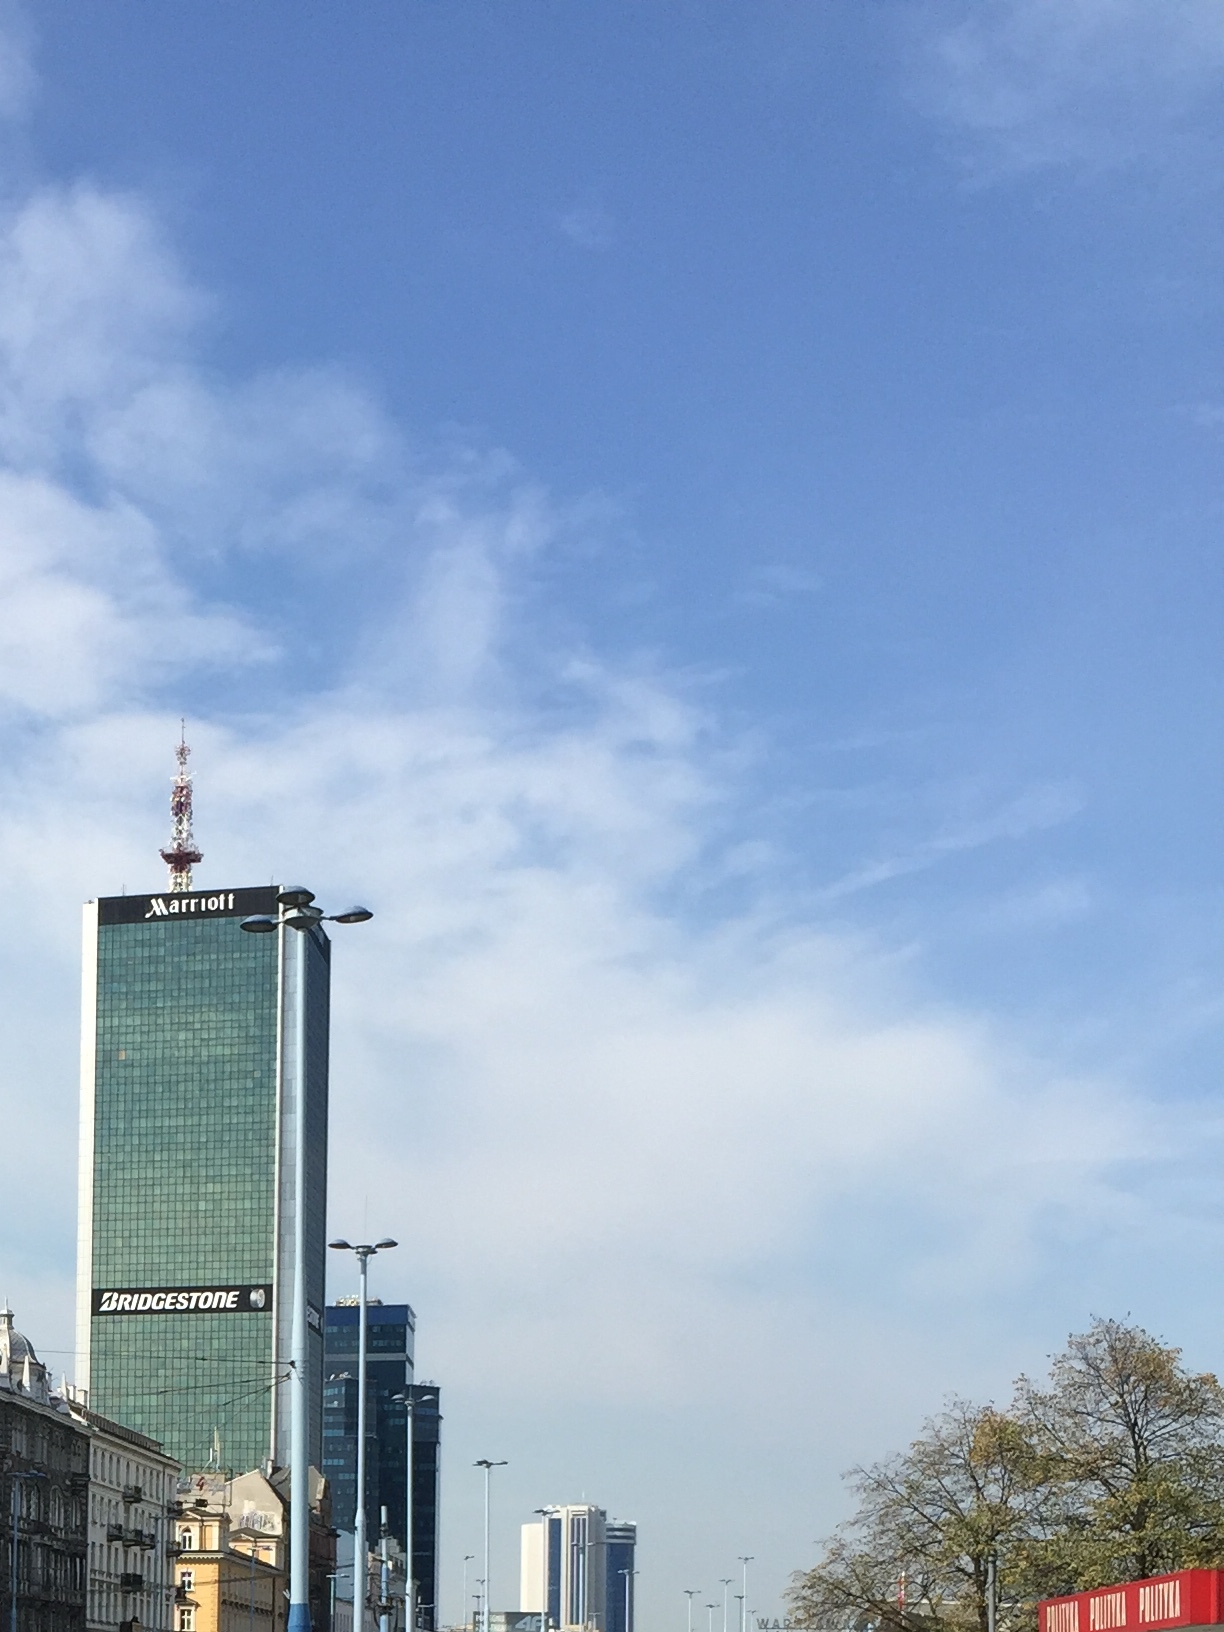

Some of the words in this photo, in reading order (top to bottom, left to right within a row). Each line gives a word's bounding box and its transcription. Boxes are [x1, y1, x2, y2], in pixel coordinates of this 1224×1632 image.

[144, 893, 235, 918] Marriott
[99, 1291, 239, 1311] BRIDGESTONE
[1089, 1591, 1126, 1632] POLITYKA
[1139, 1580, 1181, 1623] POLITYKA
